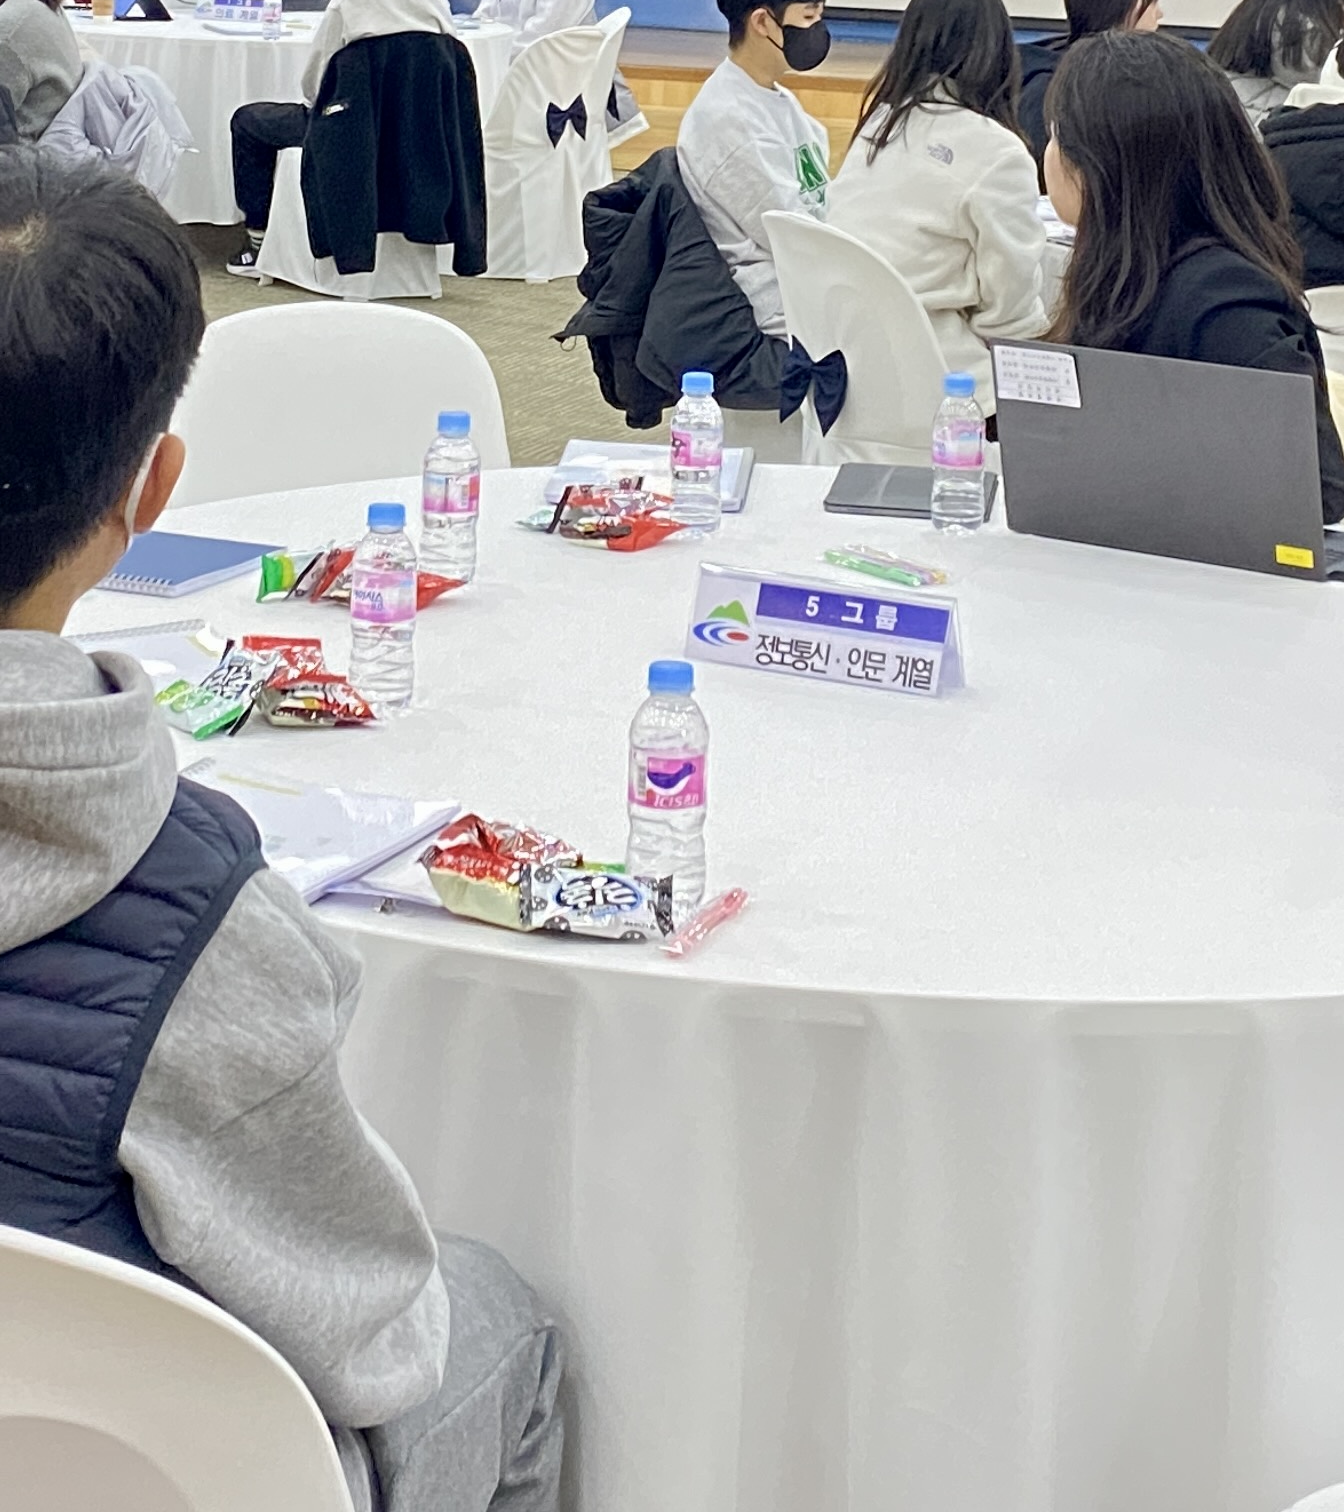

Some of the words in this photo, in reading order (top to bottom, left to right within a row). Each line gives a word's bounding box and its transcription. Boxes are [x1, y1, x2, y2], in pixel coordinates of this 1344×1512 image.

[805, 595, 820, 617] 5
[841, 600, 899, 632] 그룹
[756, 633, 832, 675] 정보통신
[847, 646, 887, 683] 인문
[892, 652, 934, 691] 계열
